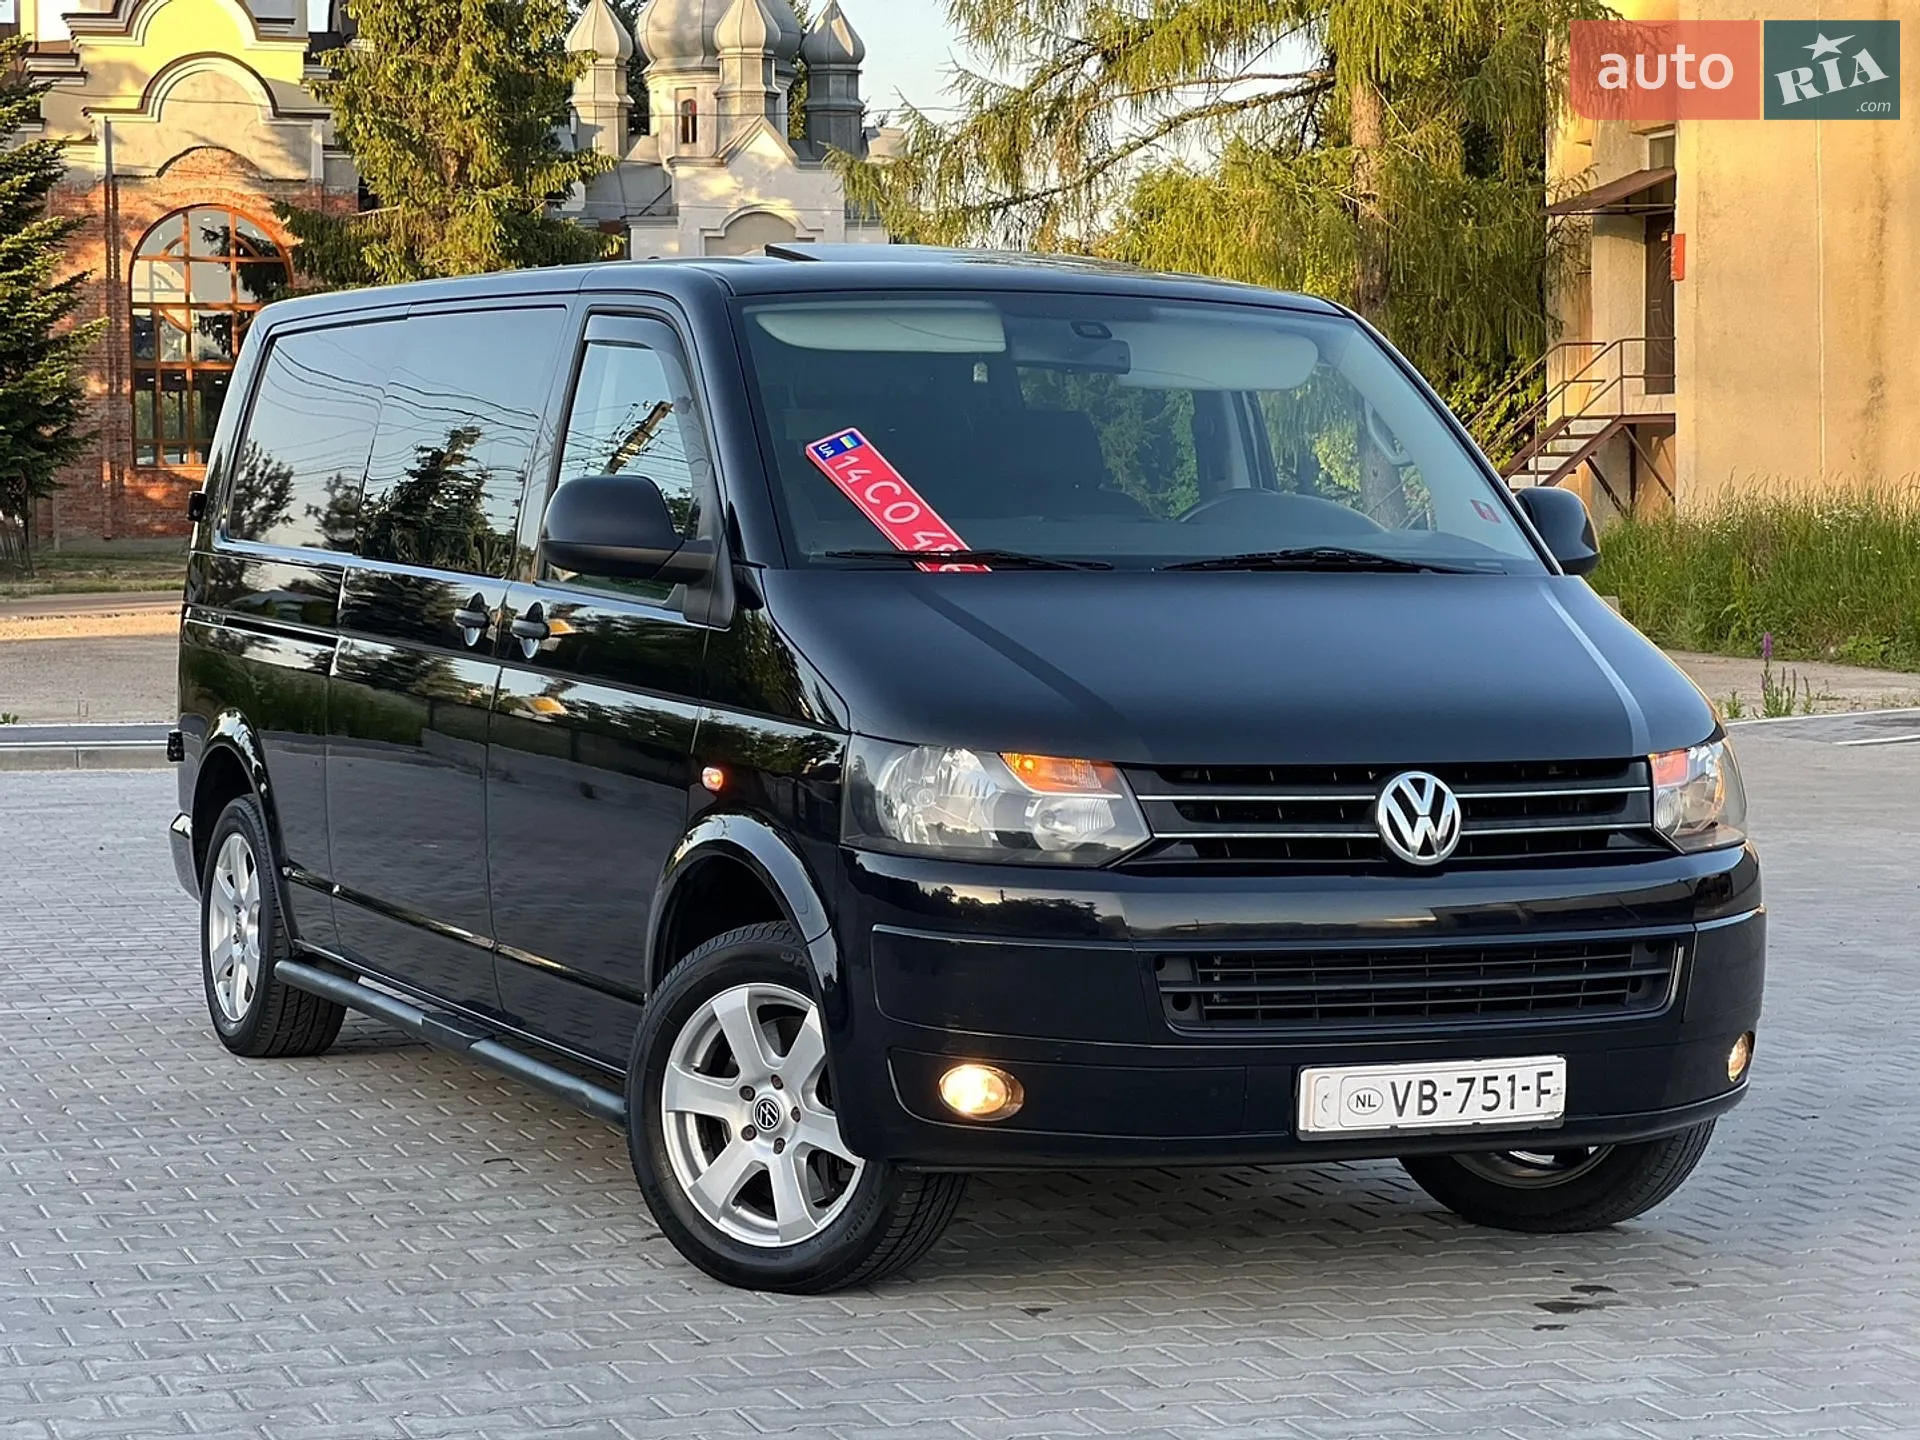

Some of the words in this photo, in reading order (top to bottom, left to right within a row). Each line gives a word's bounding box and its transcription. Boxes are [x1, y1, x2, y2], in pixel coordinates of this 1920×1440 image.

[817, 442, 836, 458] UA
[834, 455, 873, 484] 14
[1355, 1090, 1378, 1109] NL
[1390, 1070, 1555, 1118] VB-751-F
